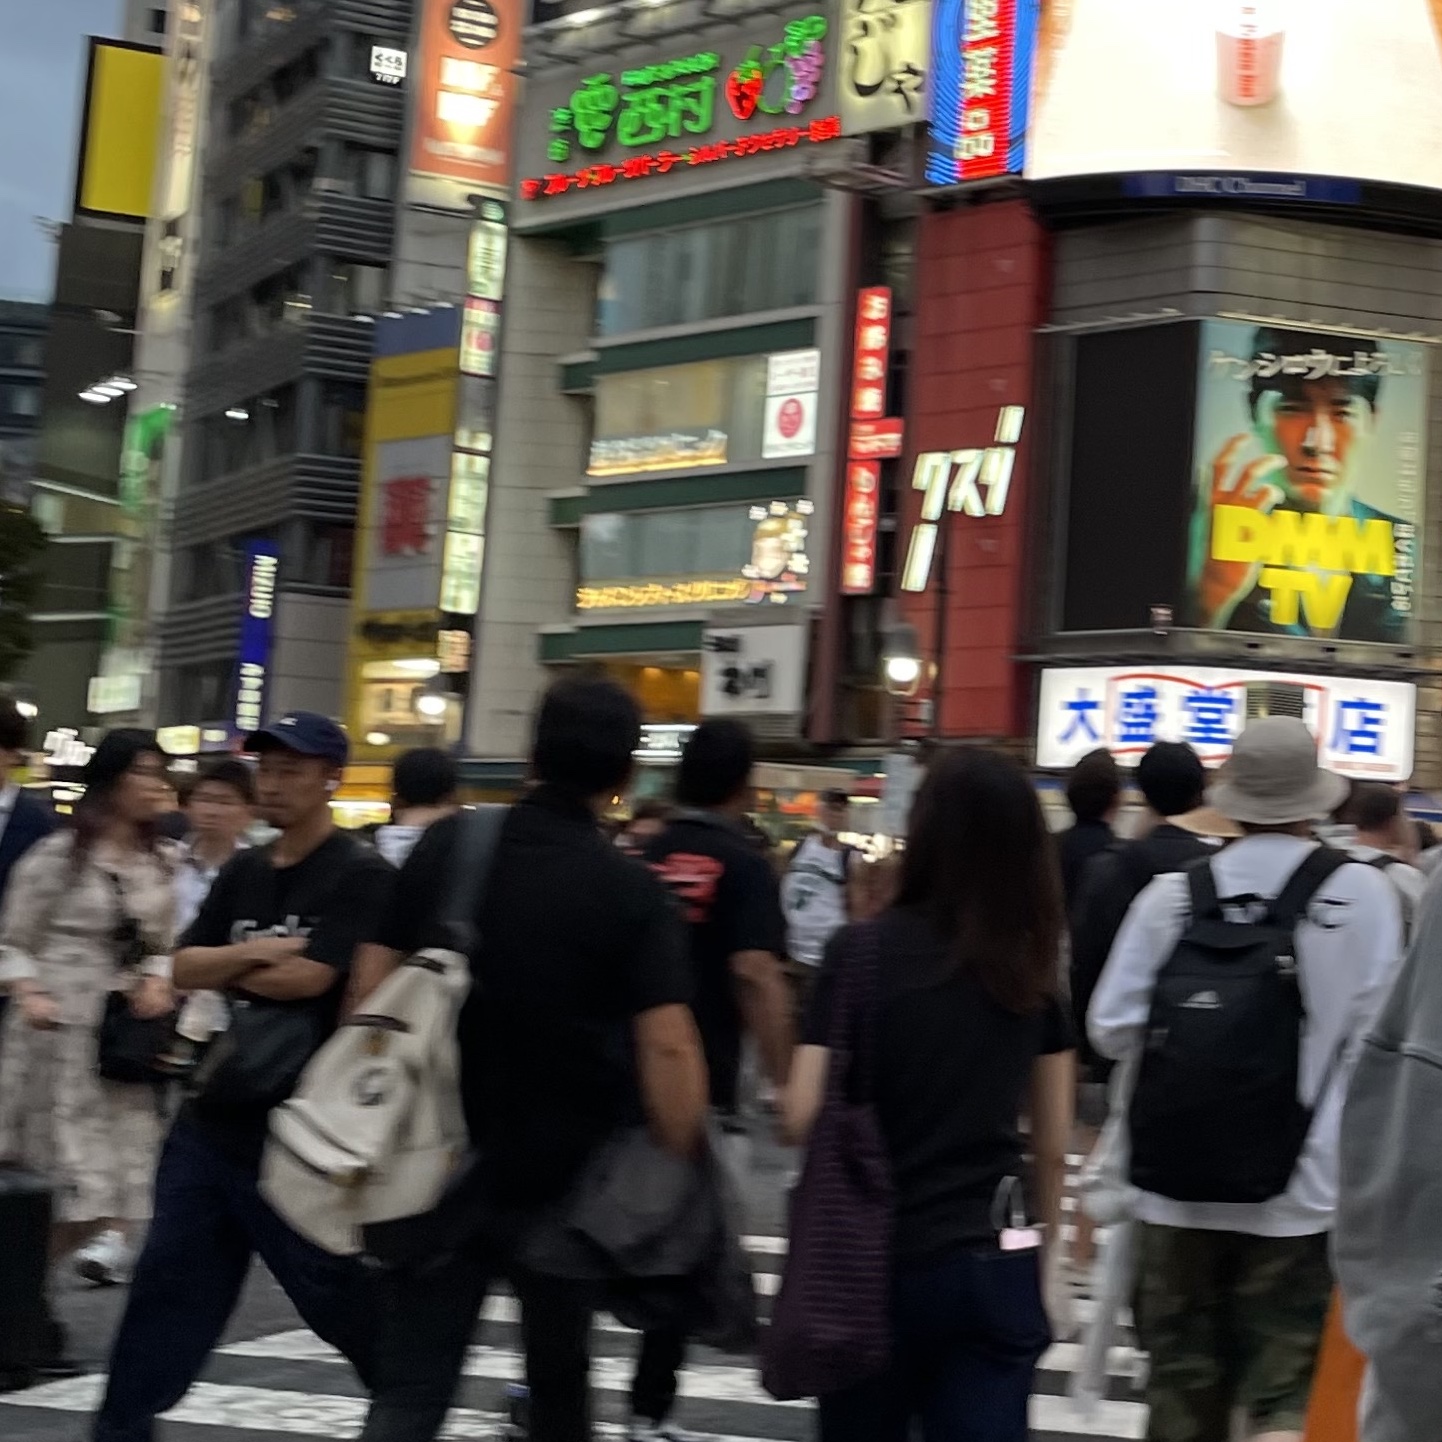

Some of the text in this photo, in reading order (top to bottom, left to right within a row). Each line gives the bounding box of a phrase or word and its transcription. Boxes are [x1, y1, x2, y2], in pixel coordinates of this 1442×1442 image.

[1212, 503, 1396, 577] DMM
[1258, 567, 1353, 629] TV
[1058, 685, 1389, 757] 大盛堂店
